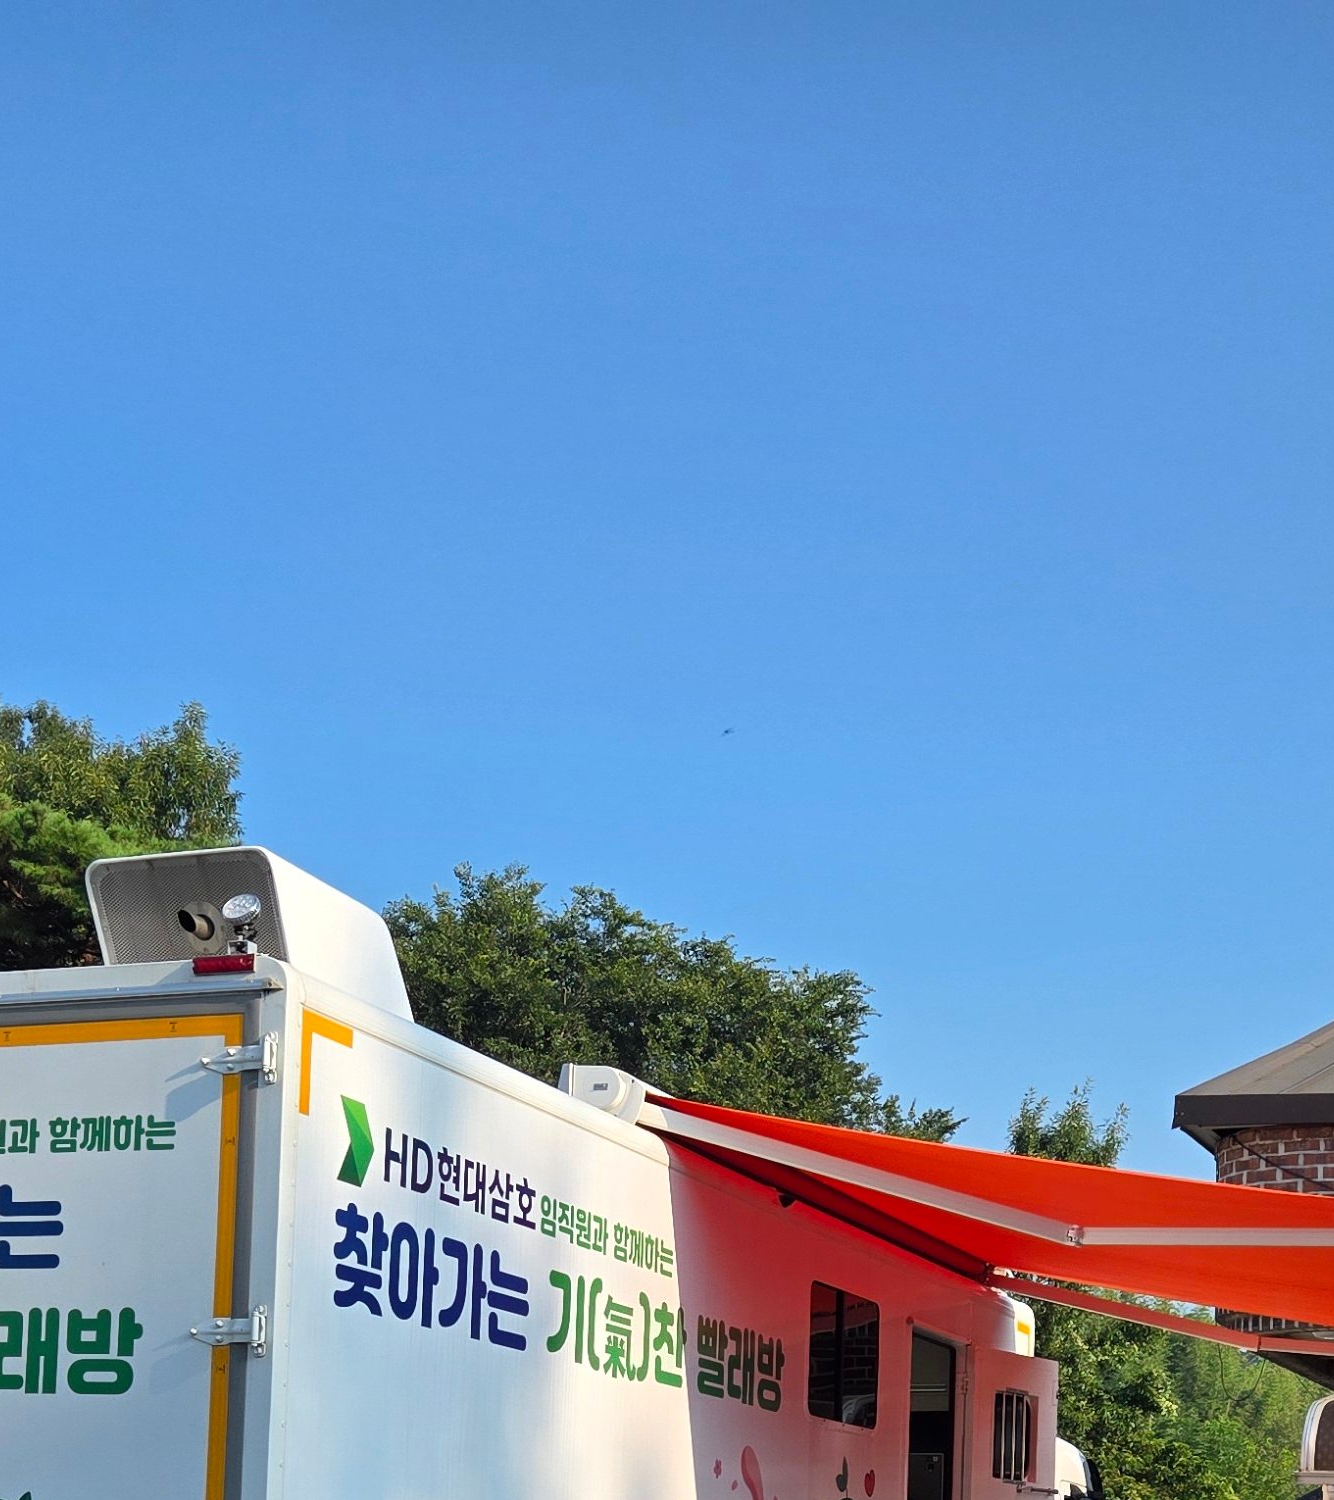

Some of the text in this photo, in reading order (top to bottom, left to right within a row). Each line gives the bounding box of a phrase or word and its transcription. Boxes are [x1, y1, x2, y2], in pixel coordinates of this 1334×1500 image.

[49, 1114, 176, 1153] 함께하는
[383, 1127, 674, 1278] HD현대삼호 임직원과 함께하는
[333, 1202, 786, 1413] 찾아가는 기(氣)찬 빨래방
